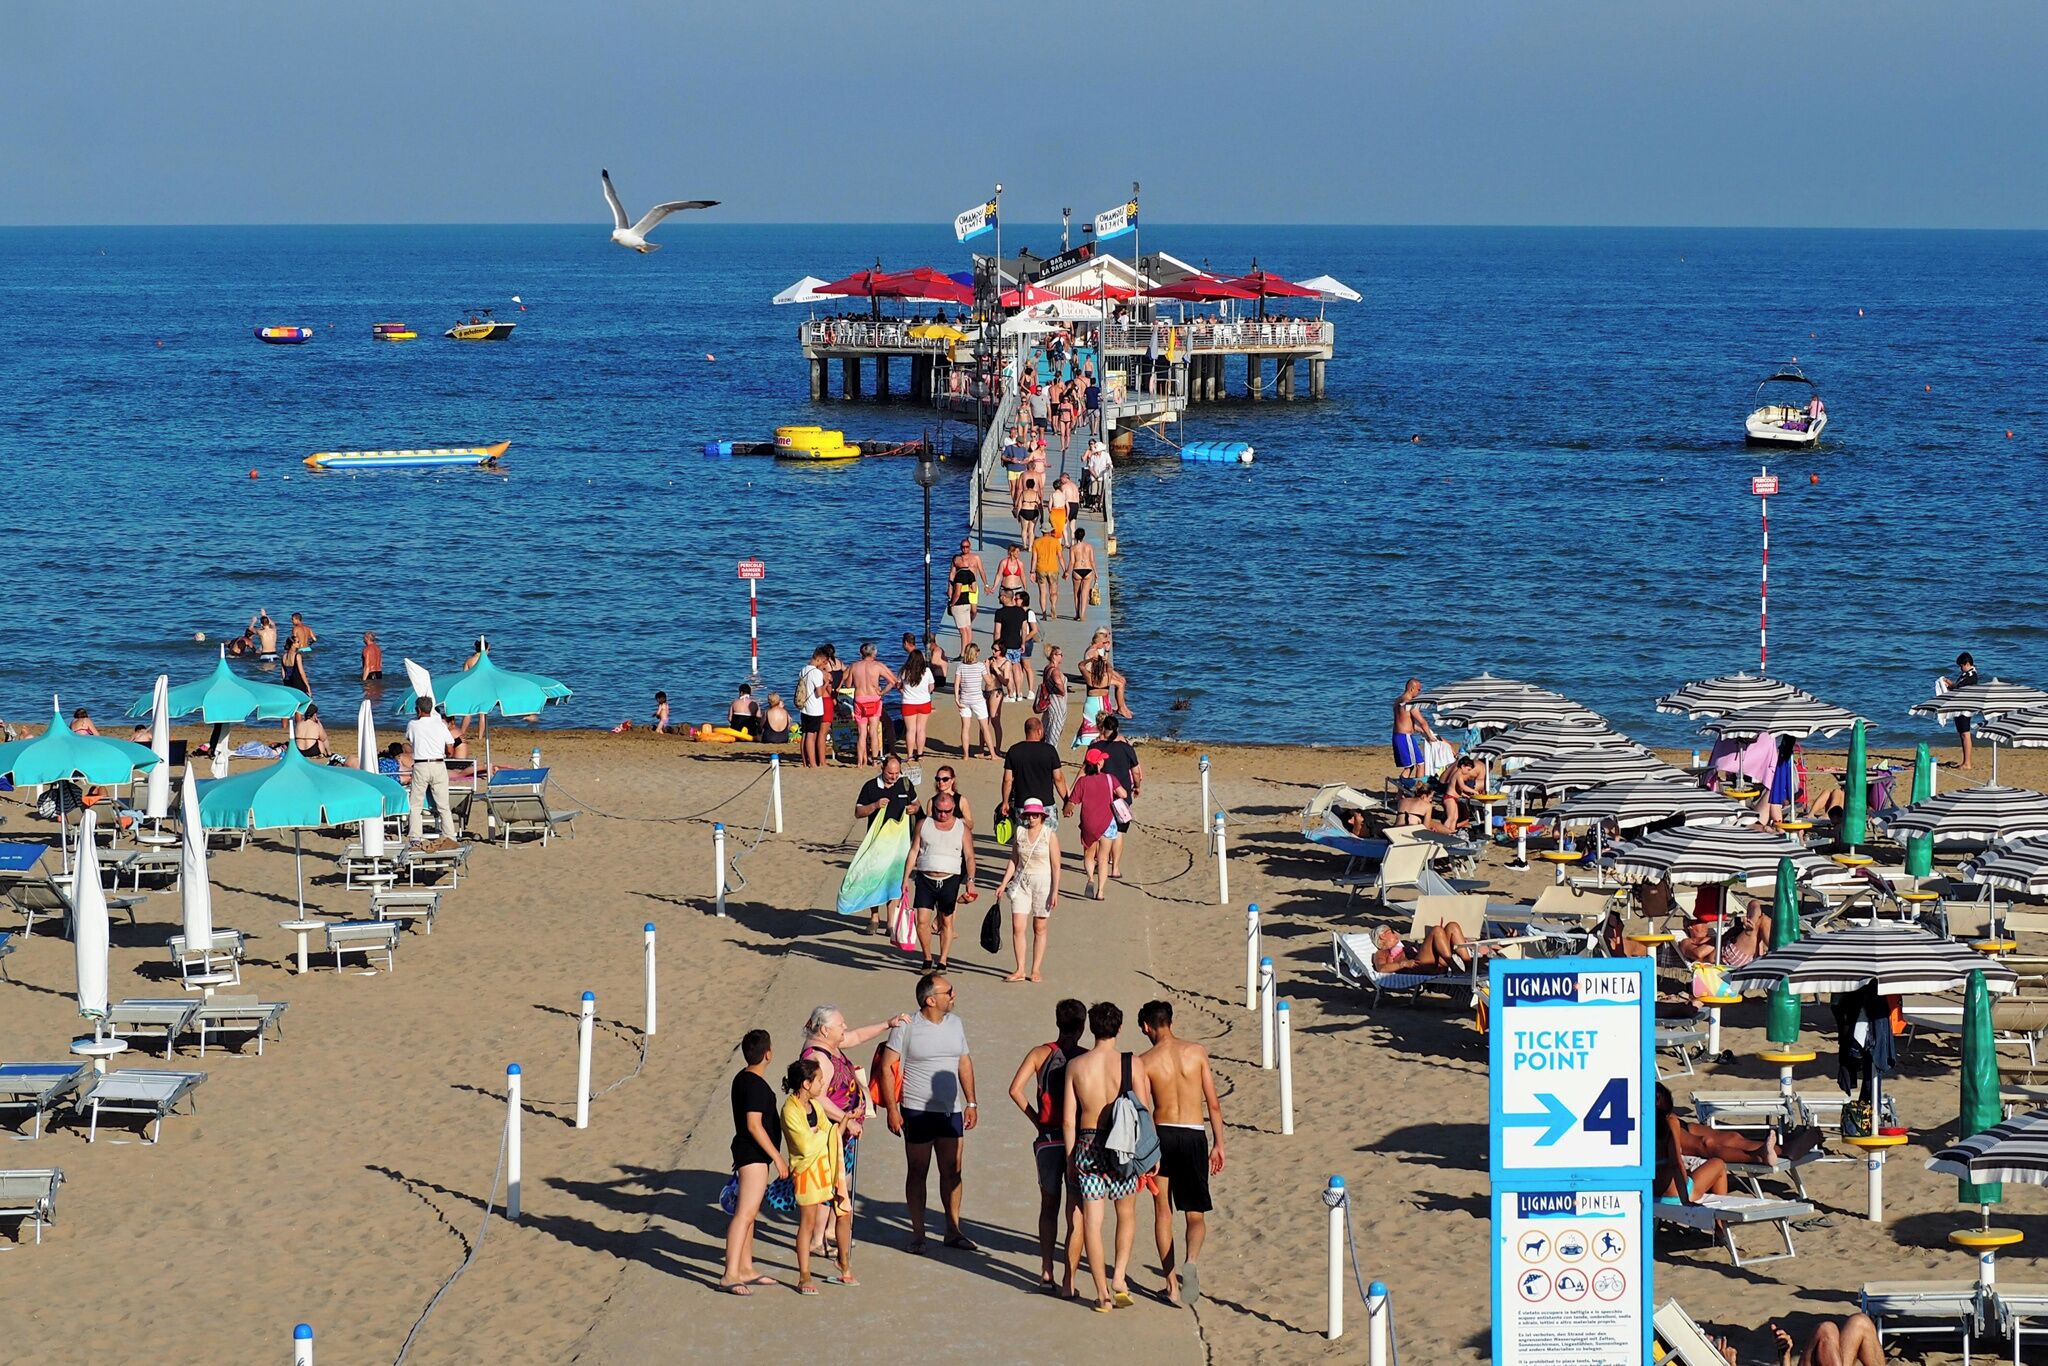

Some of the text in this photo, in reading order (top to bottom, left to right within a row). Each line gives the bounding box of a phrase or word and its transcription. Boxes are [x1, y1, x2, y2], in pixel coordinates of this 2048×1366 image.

[1041, 257, 1077, 276] LA PAGODA
[1050, 256, 1063, 266] BAR
[1507, 977, 1635, 996] LIGNANO PINETA
[1514, 1030, 1598, 1049] TICKET
[1514, 1052, 1589, 1070] POINT
[1583, 1078, 1635, 1145] 4
[1521, 1195, 1620, 1211] LIGNANO PINETA
